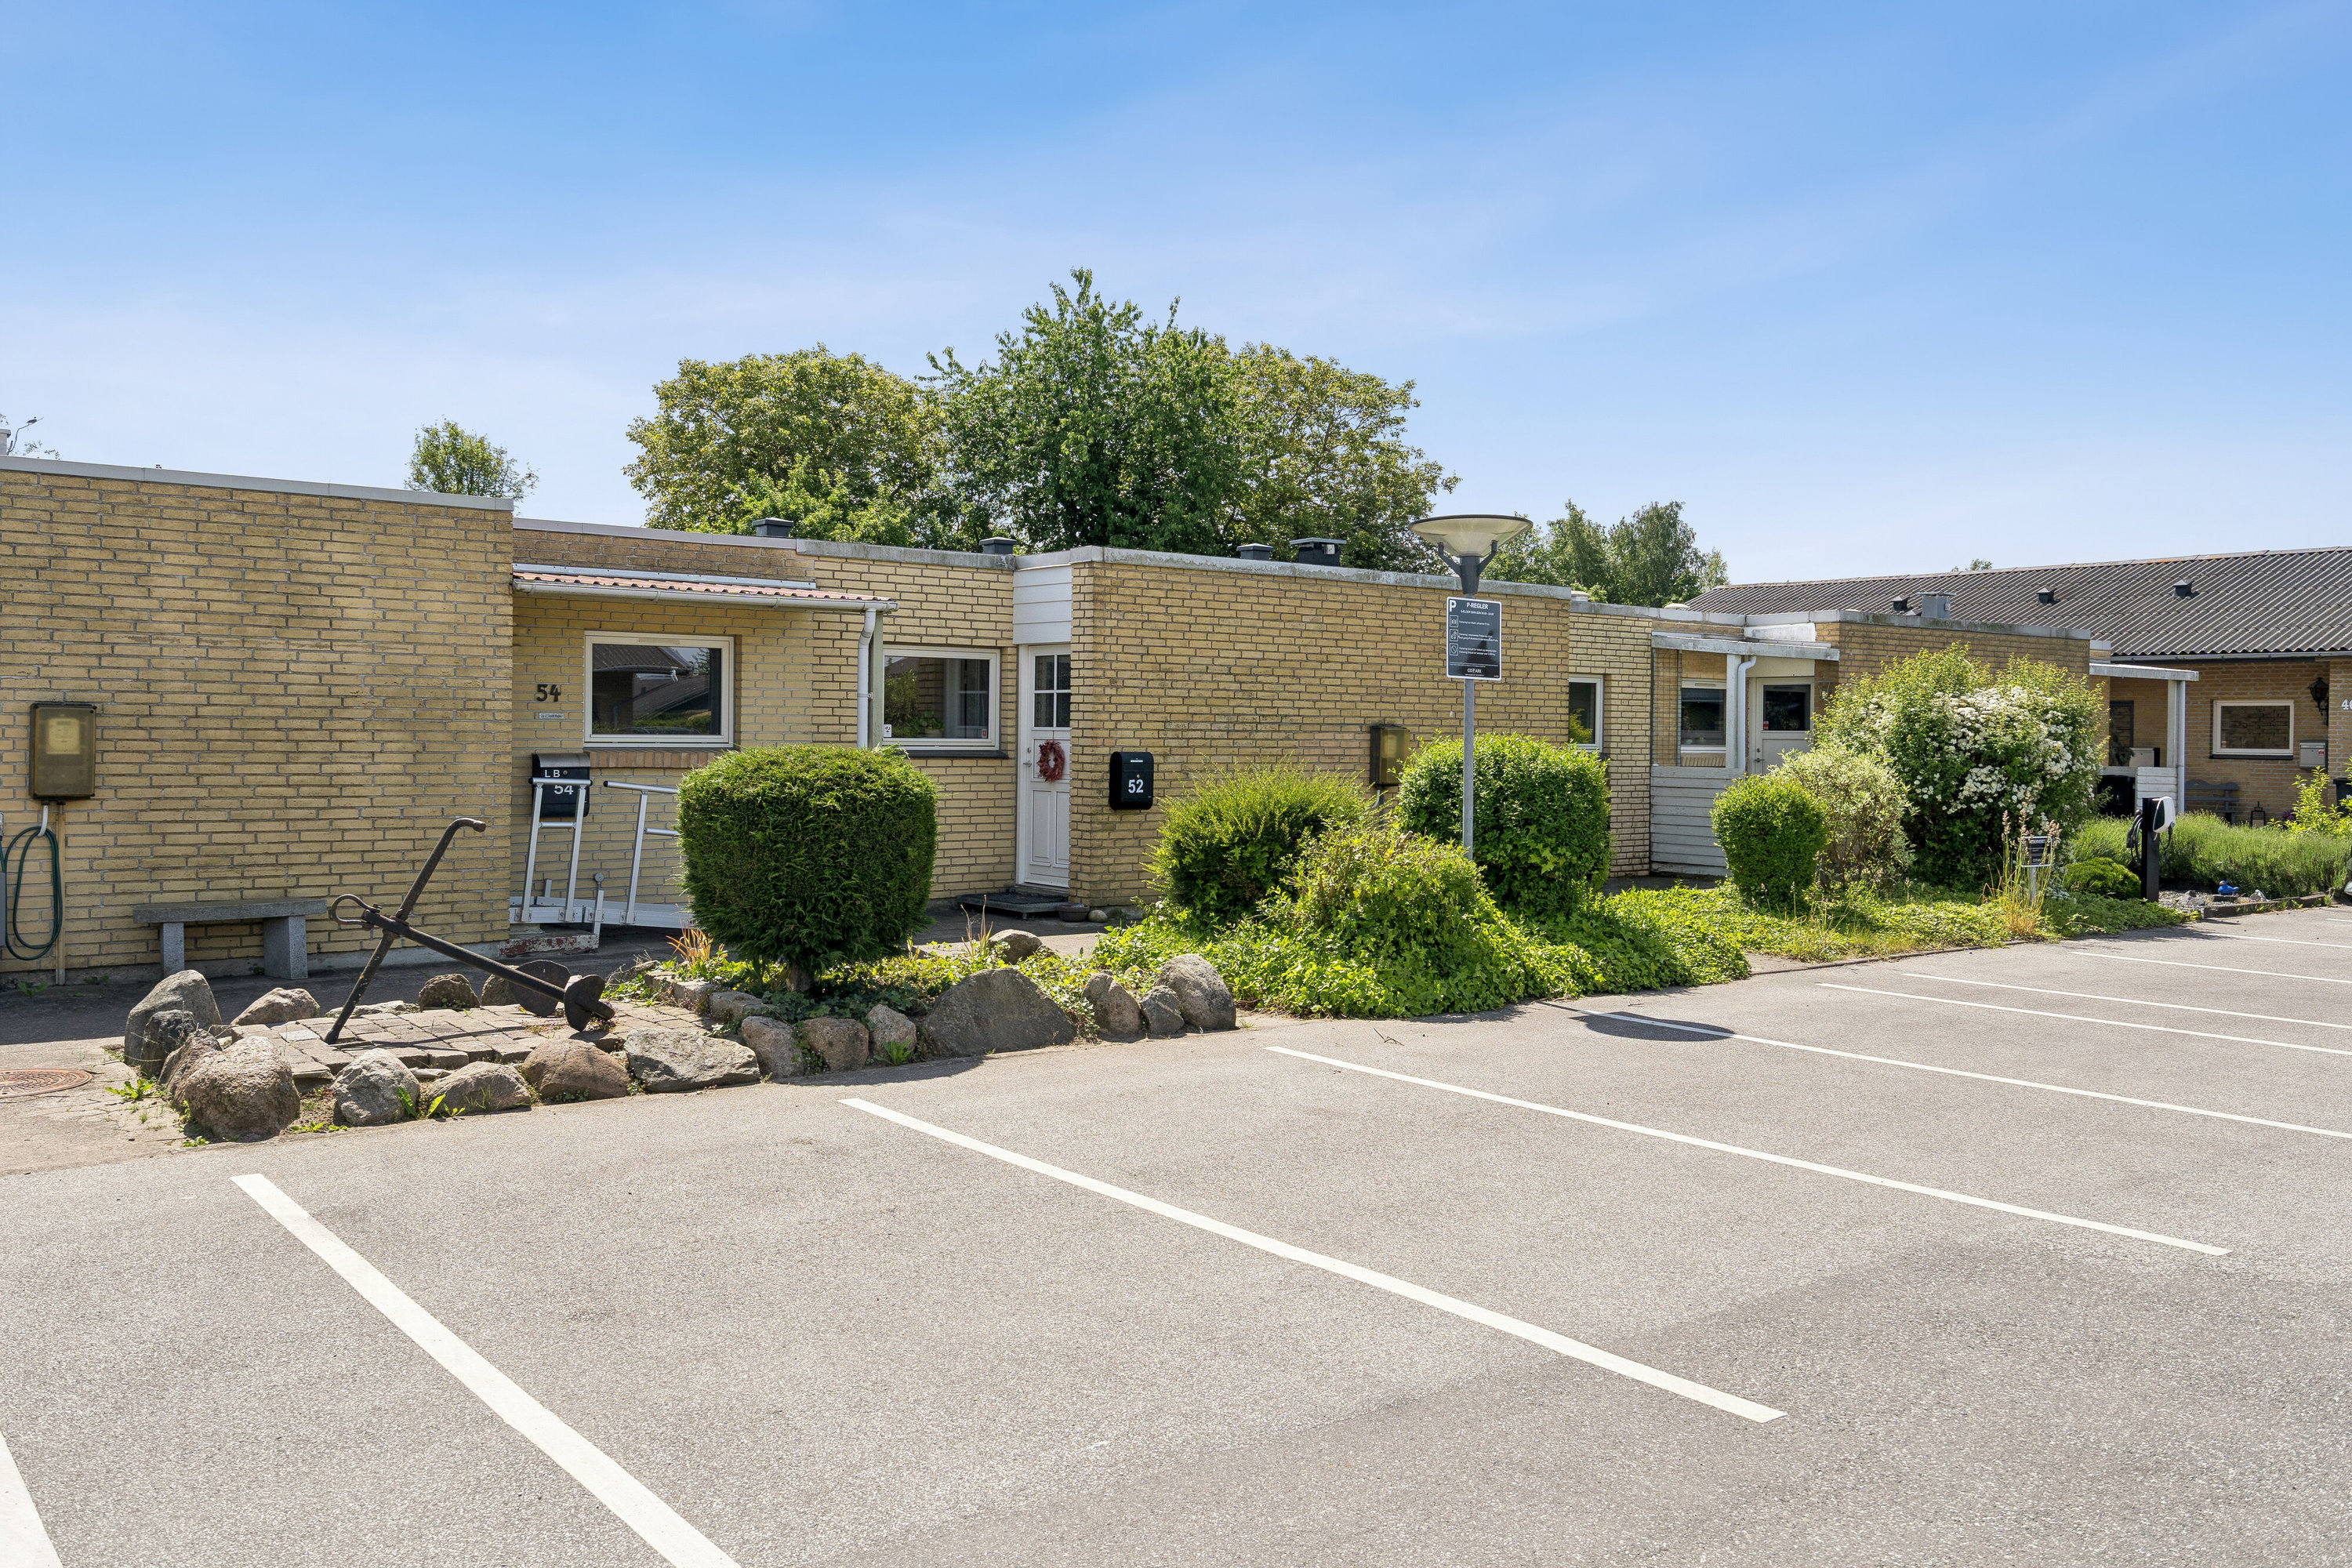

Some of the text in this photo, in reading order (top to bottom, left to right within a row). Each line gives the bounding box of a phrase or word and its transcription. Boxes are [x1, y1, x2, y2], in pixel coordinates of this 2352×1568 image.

[1450, 600, 1457, 612] P
[536, 684, 561, 702] 54
[554, 784, 574, 795] 54
[1128, 779, 1144, 793] 52
